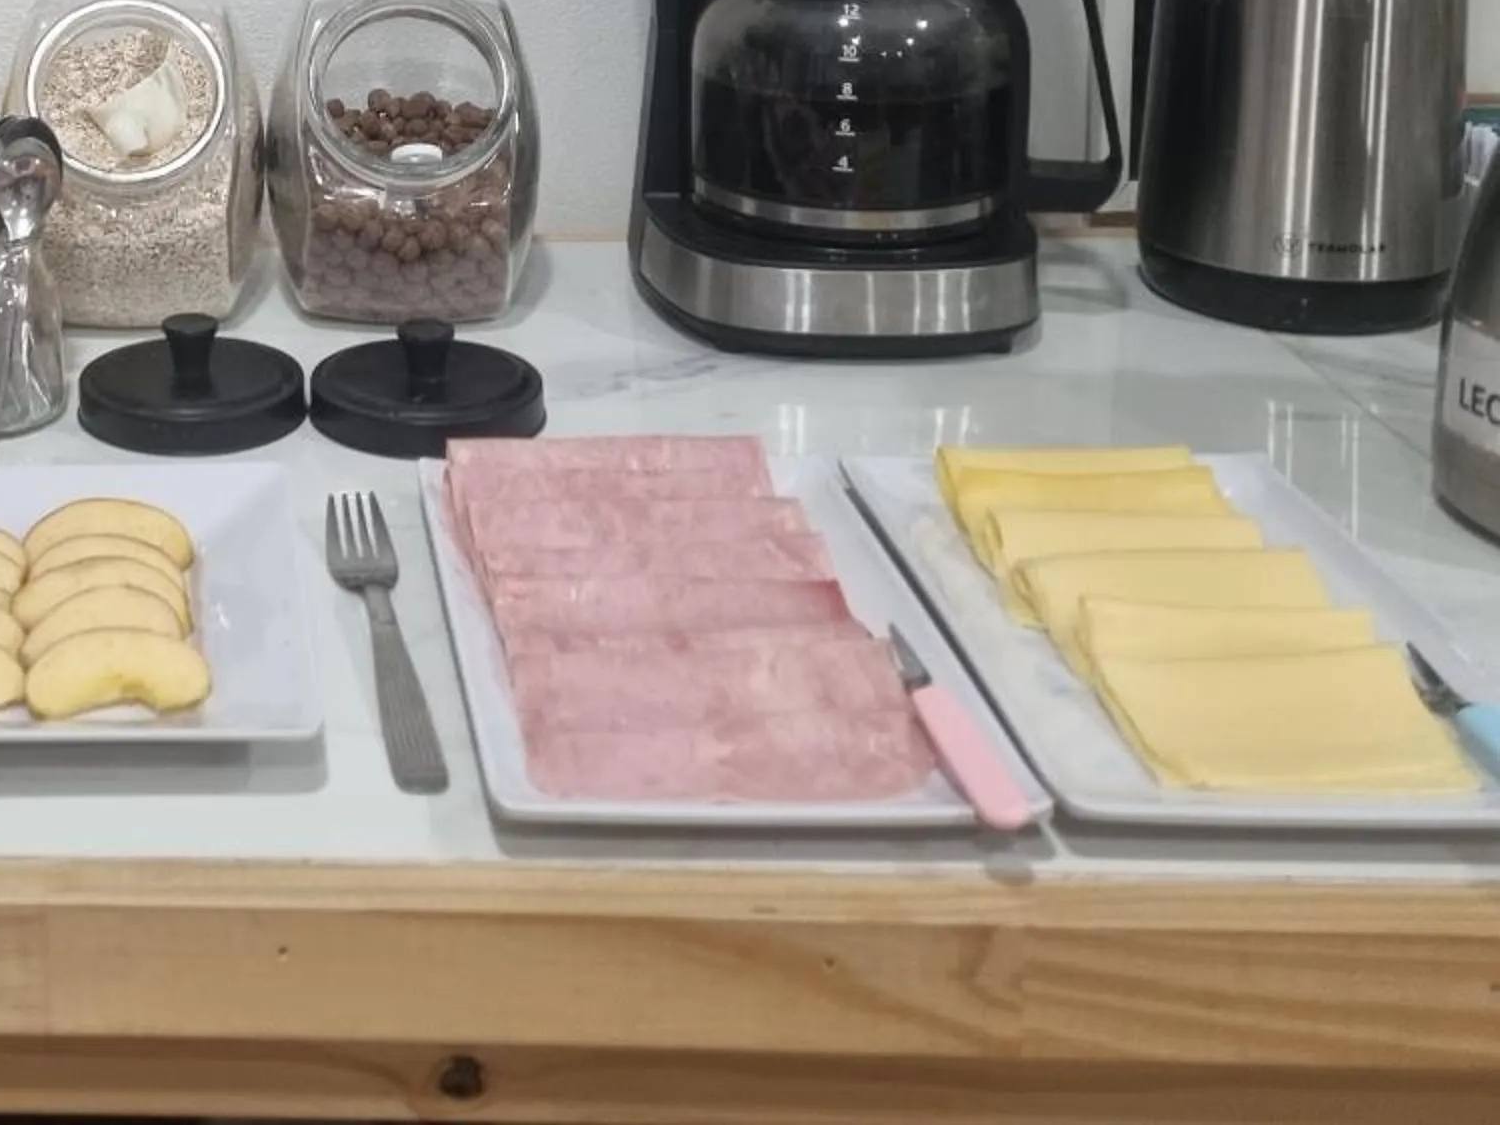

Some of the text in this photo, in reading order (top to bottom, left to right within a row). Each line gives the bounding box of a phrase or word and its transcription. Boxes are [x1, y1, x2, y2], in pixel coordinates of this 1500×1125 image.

[843, 3, 860, 17] 12
[842, 44, 858, 58] 10
[841, 82, 853, 95] 8
[840, 118, 851, 132] 6
[838, 155, 849, 169] 4
